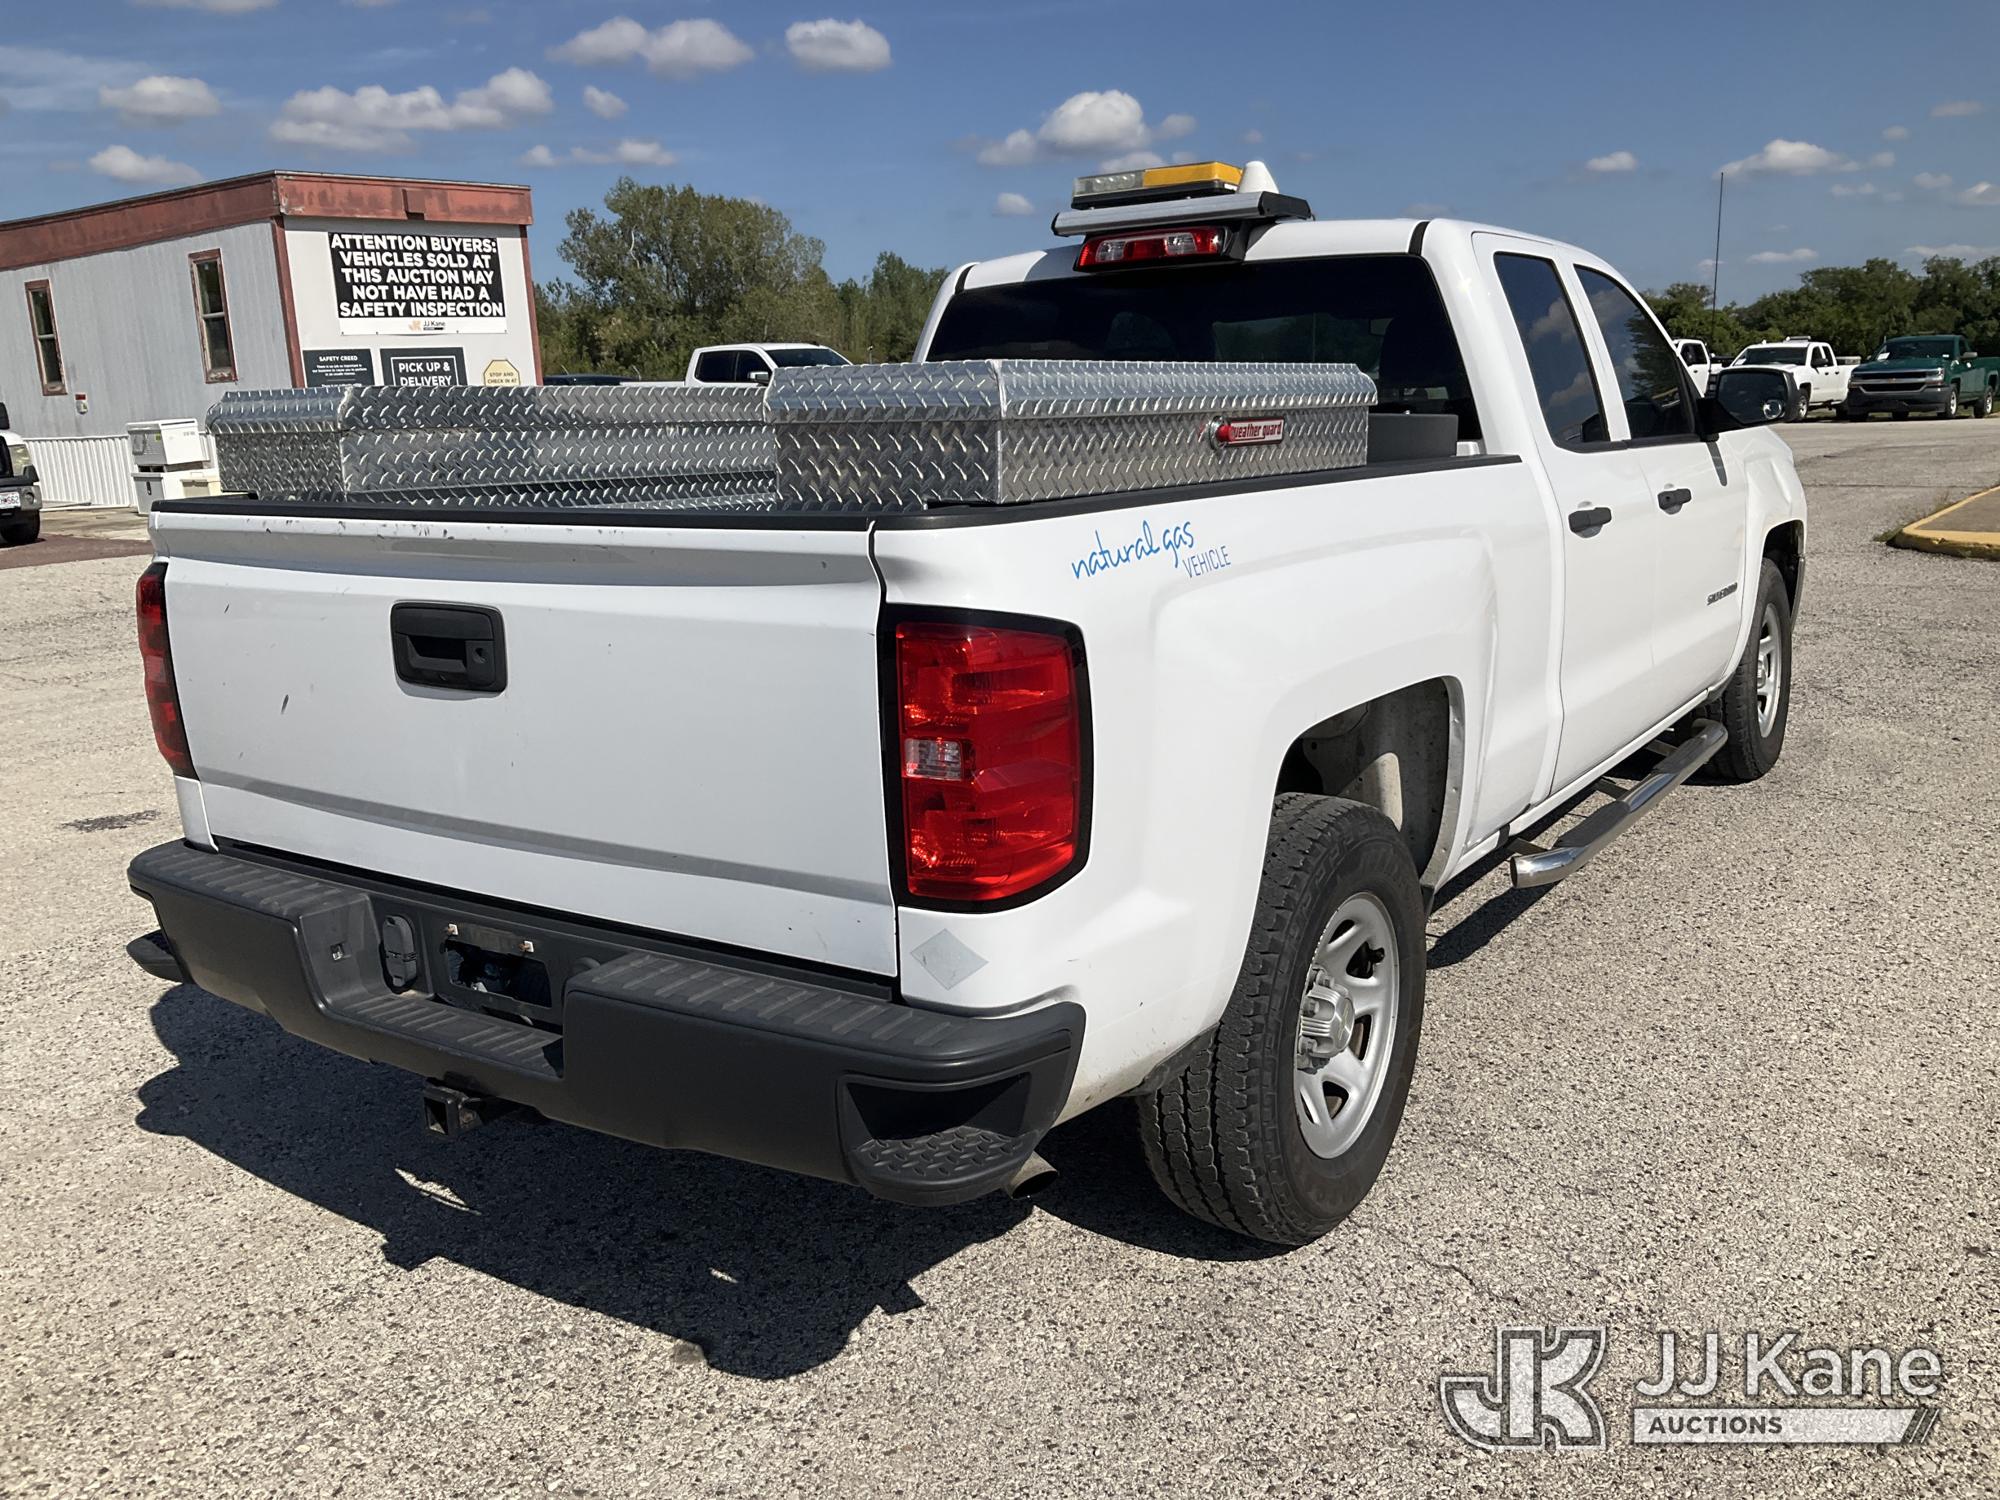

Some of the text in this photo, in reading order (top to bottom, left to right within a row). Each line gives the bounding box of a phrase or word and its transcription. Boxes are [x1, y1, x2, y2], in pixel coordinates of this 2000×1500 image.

[331, 234, 497, 253] ATTENTION BUYERS:
[339, 251, 491, 269] VEHICLES SOLD AT
[341, 268, 494, 285] THIS AUCTION MAY
[352, 285, 490, 300] NOT HAVE HAD A
[340, 302, 504, 317] SAFETY INSPECTION
[398, 361, 451, 373] PICK UP &
[400, 375, 452, 386] DELIVERY
[1262, 422, 1282, 436] guard
[1071, 520, 1194, 580] natural gas
[1182, 545, 1232, 579] VEHICLE
